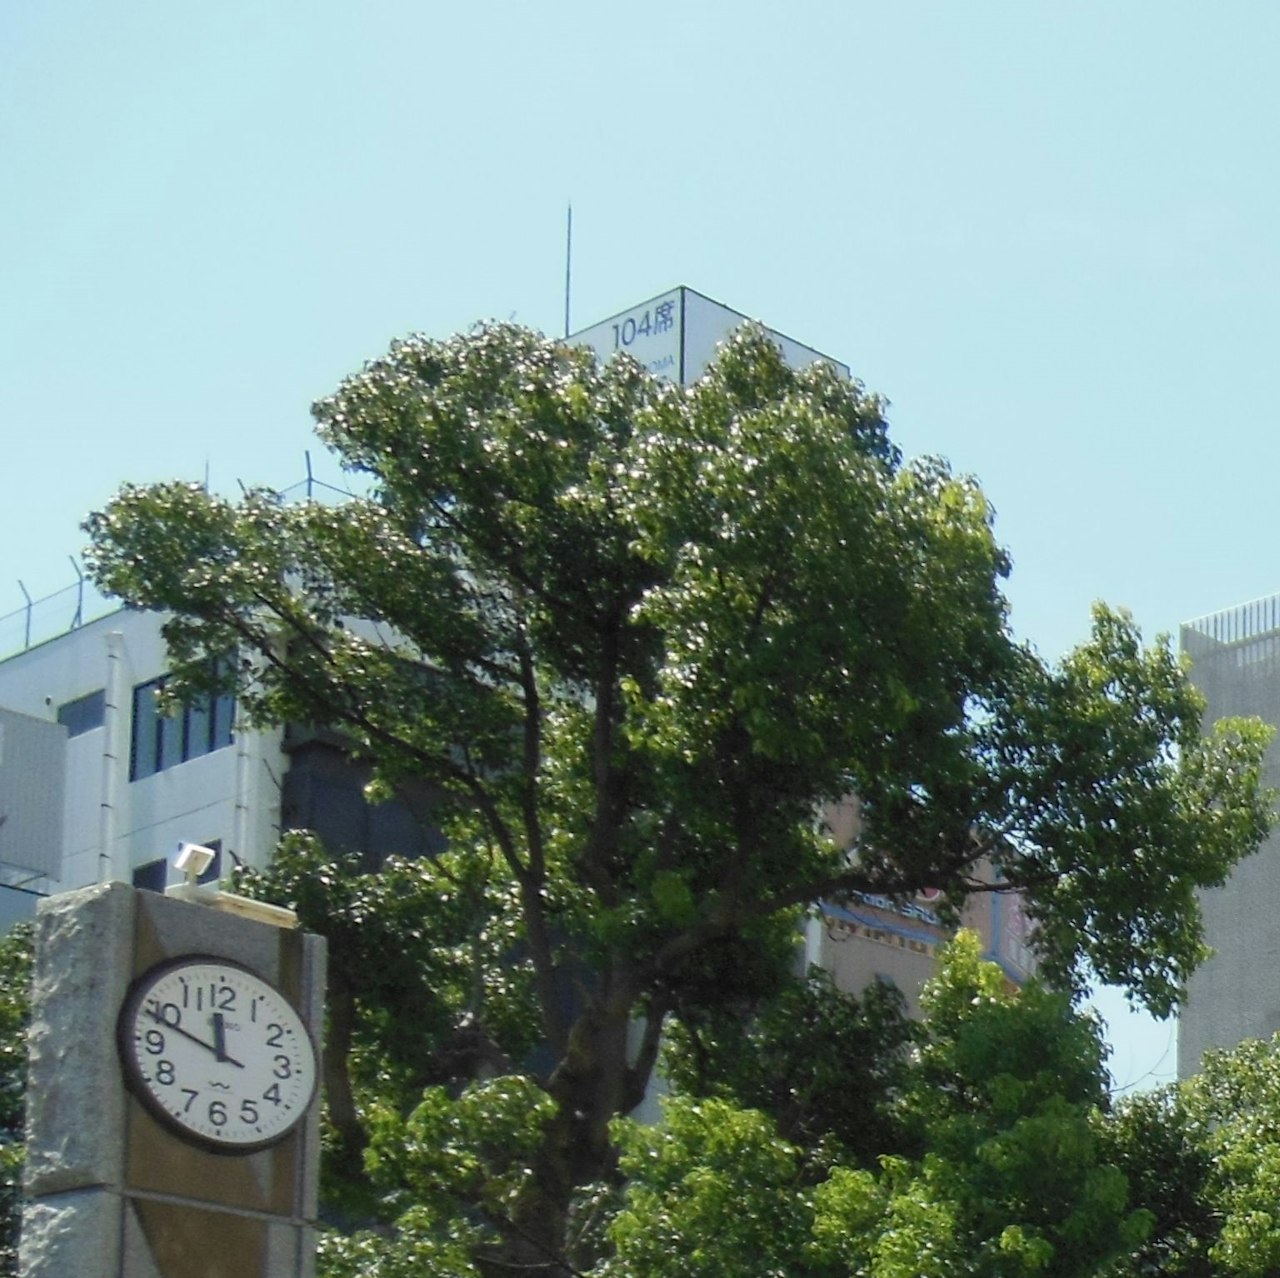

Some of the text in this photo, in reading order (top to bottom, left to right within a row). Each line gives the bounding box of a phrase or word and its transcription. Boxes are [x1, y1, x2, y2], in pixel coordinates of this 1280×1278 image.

[181, 983, 204, 1012] 11
[210, 983, 237, 1012] 12
[250, 998, 257, 1023] 1
[145, 1029, 165, 1055] 9
[266, 1023, 285, 1049] 2
[155, 1059, 176, 1086] 8
[272, 1054, 292, 1081] 3
[180, 1088, 200, 1113] 7
[262, 1083, 283, 1106] 4
[208, 1101, 228, 1126] 6
[239, 1100, 260, 1125] 5
